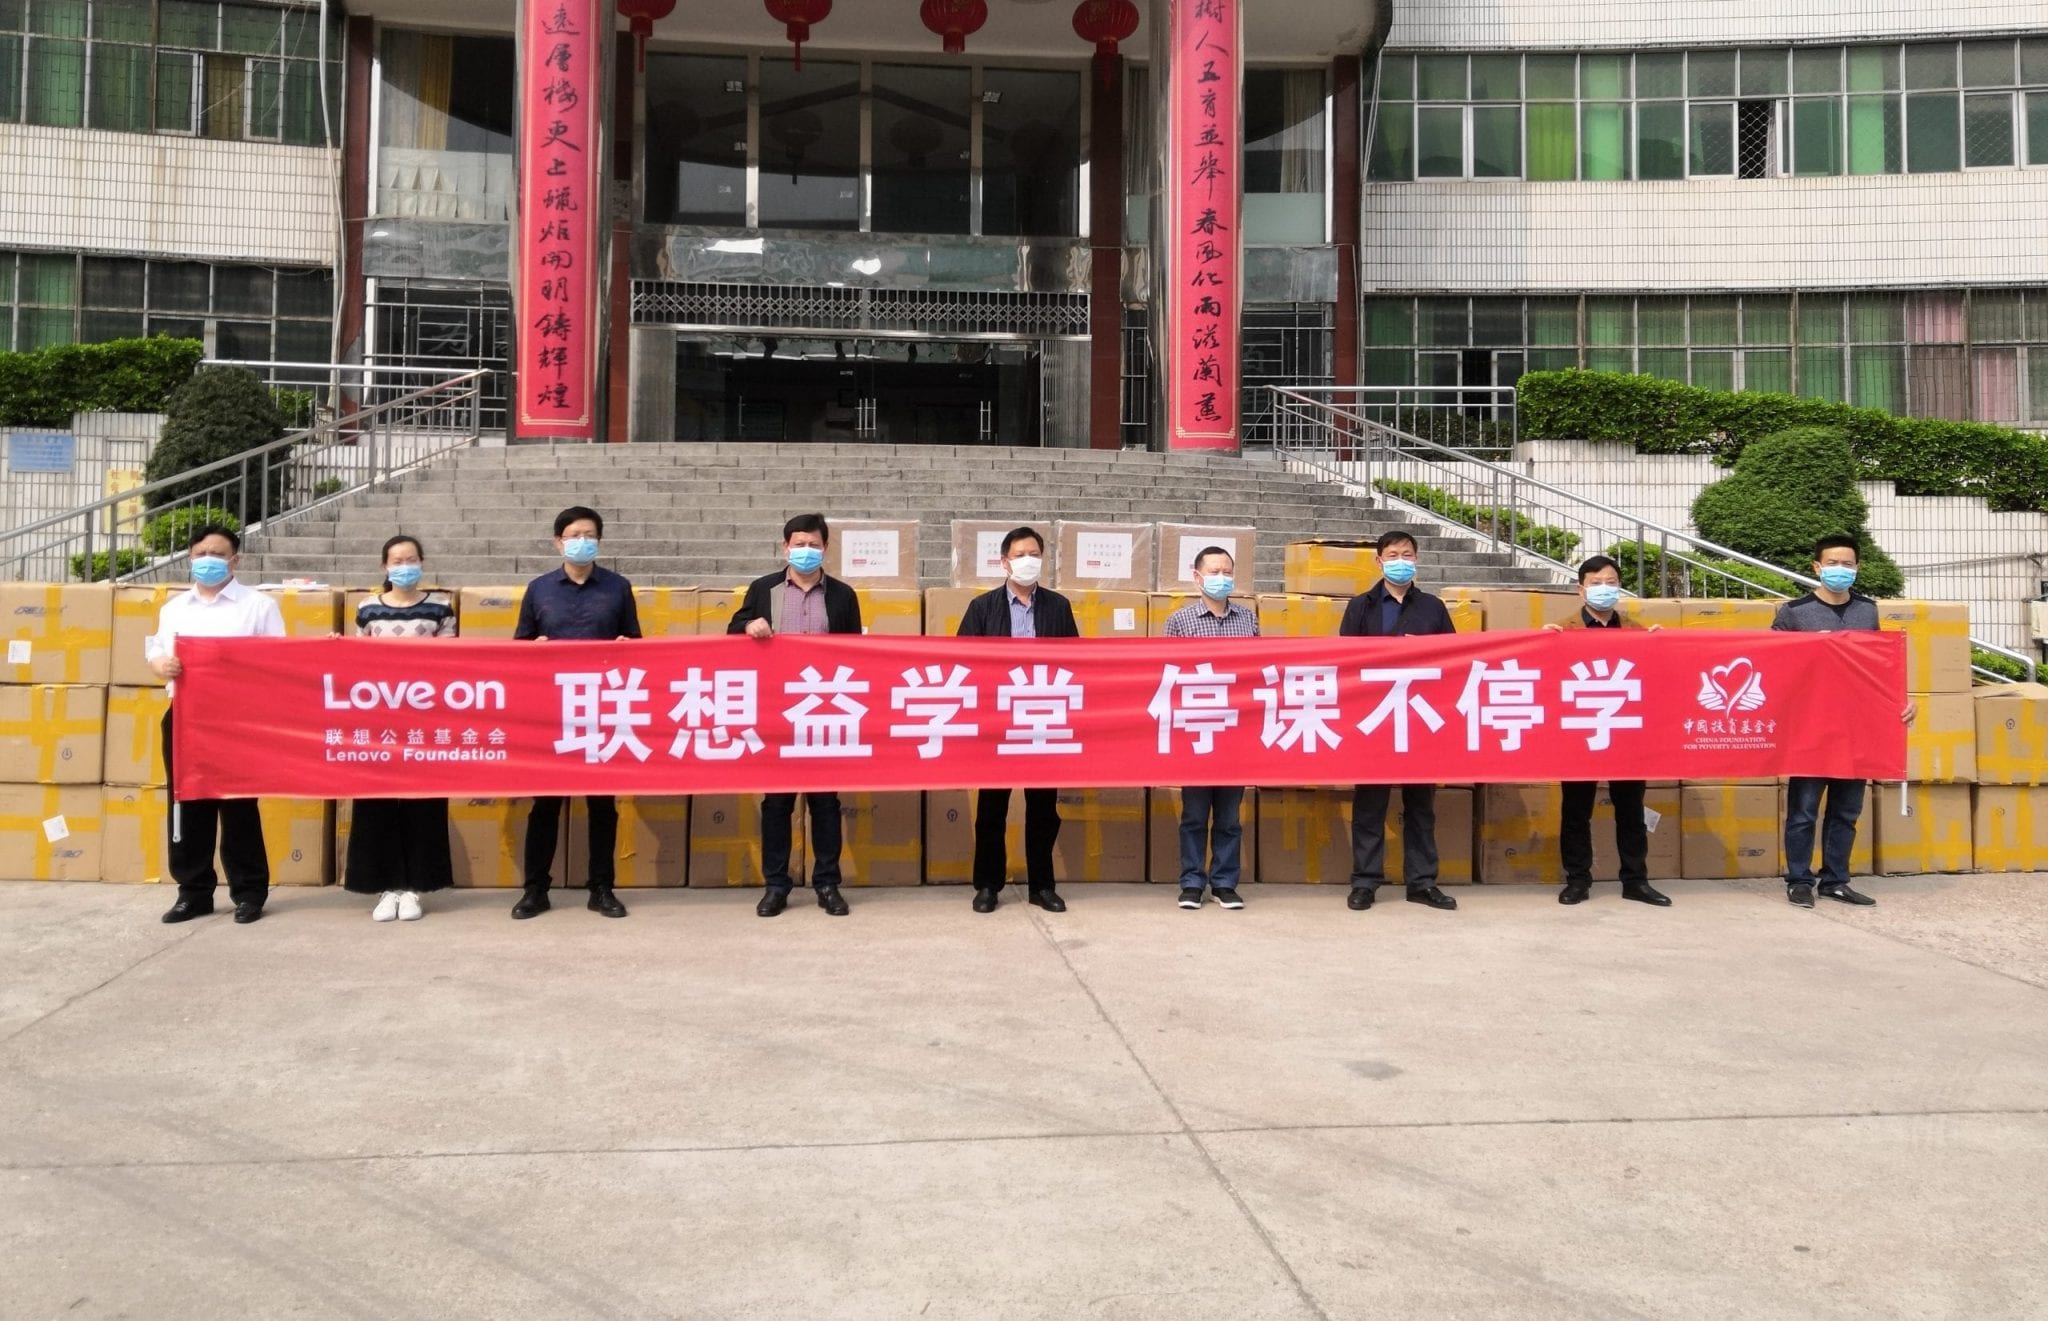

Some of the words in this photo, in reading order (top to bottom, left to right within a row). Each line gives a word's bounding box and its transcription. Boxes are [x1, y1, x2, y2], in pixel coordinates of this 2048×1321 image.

[323, 674, 435, 710] Love
[444, 681, 506, 710] on
[553, 665, 1084, 764] 联想益学堂
[1147, 658, 1643, 755] 停课不停学
[325, 728, 506, 746] 联想公益基金会
[326, 749, 391, 762] Lenovo
[403, 747, 507, 762] Foundation
